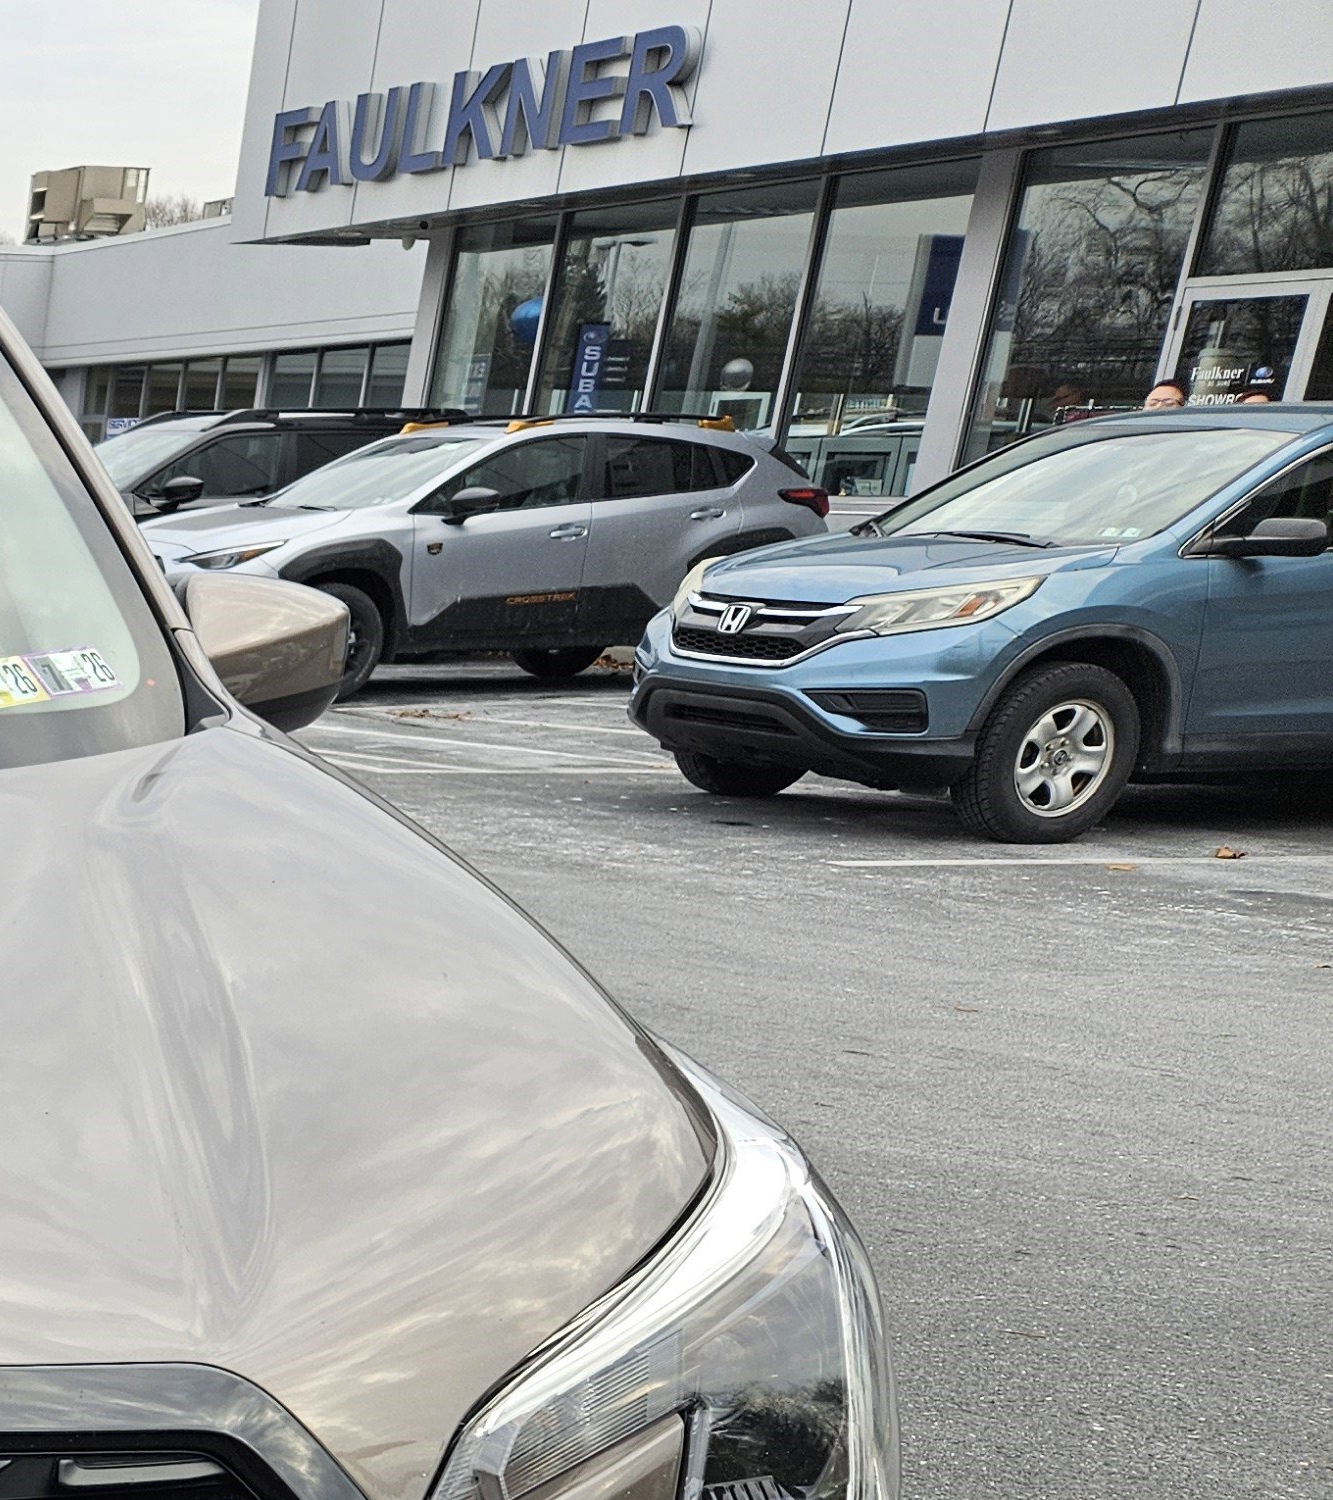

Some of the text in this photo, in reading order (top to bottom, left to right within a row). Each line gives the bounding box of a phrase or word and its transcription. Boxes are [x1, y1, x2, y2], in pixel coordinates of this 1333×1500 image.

[265, 25, 701, 198] FAULKNER
[574, 346, 602, 413] SUBA
[1190, 366, 1244, 381] Faulkner
[3, 663, 38, 694] 26
[81, 652, 115, 682] 26
